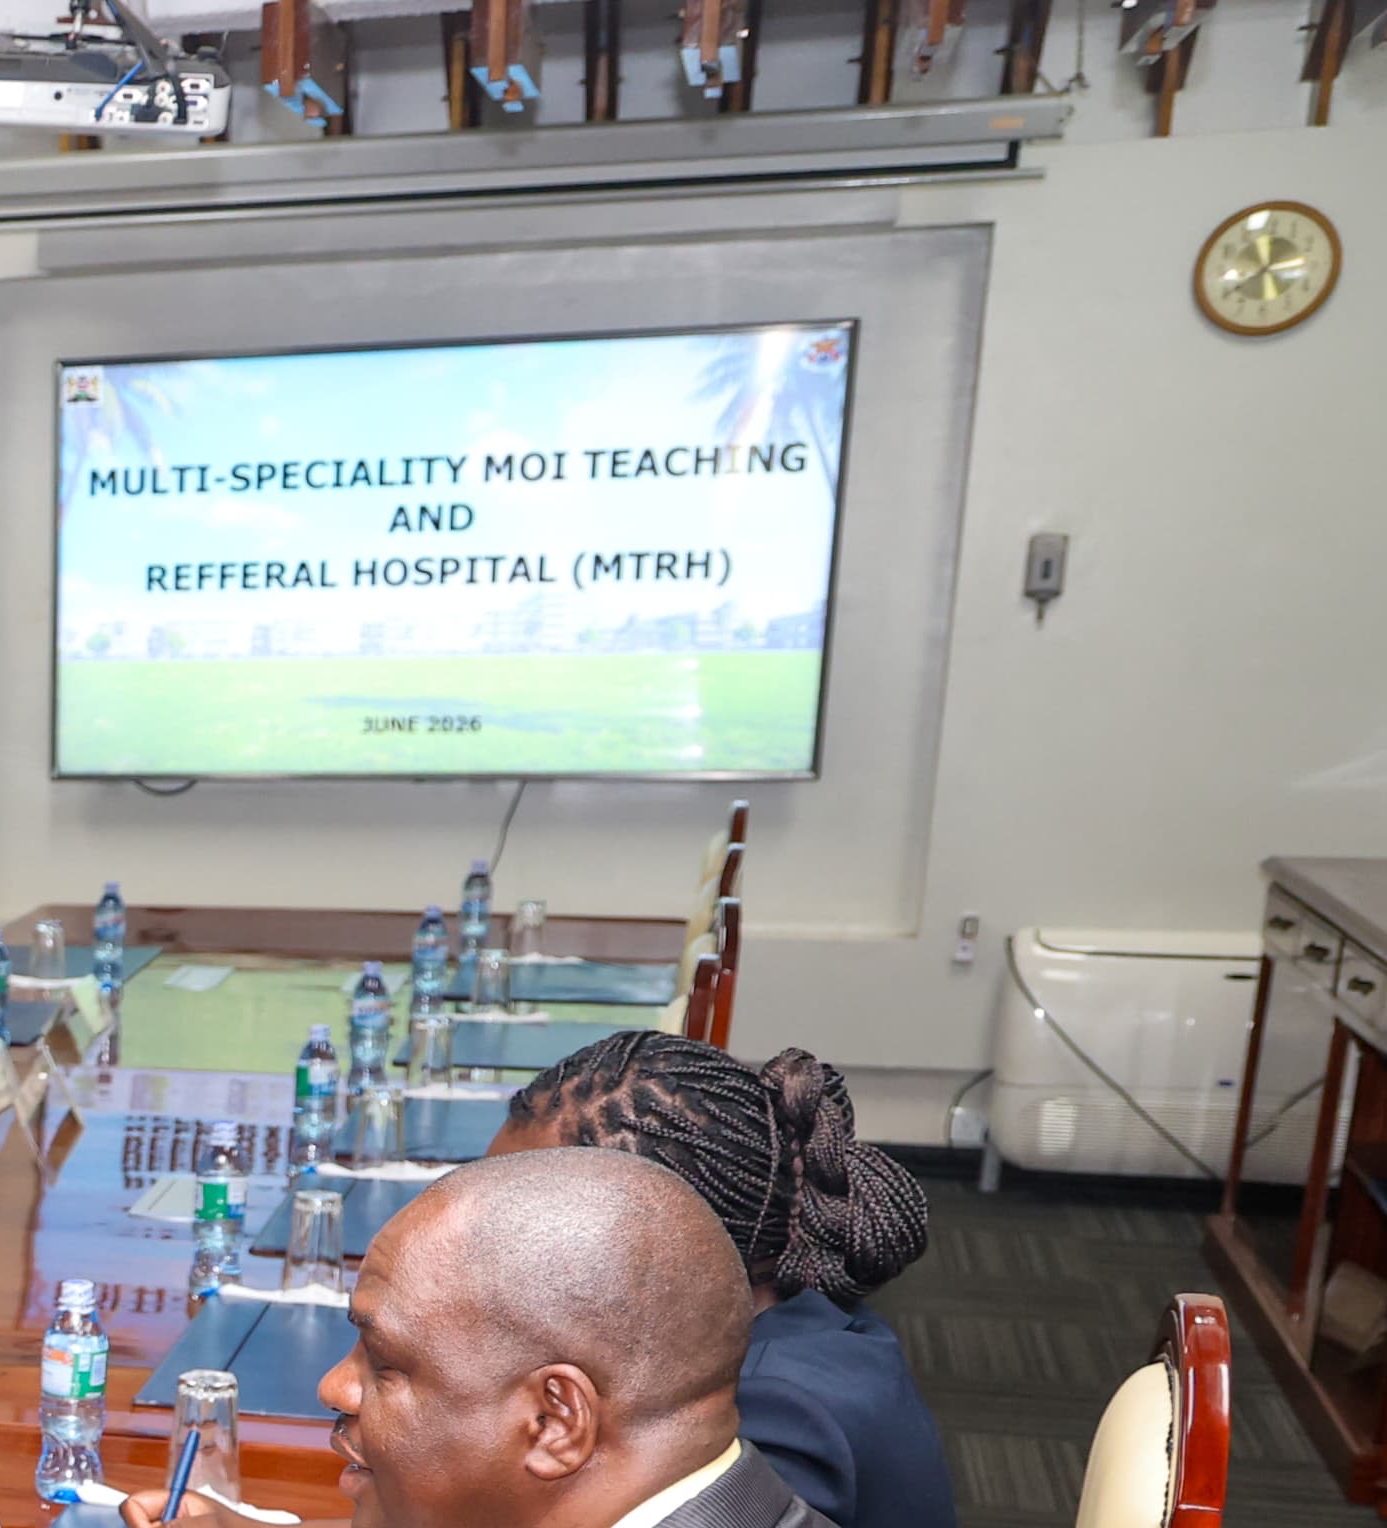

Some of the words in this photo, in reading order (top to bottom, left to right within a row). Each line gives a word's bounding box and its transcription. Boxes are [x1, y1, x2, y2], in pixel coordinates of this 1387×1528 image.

[89, 455, 468, 496] MULTI-SPECIALITY
[484, 451, 568, 483] MOI
[584, 442, 809, 479] TEACHING
[389, 503, 475, 533] AND
[145, 560, 337, 592] REFFERAL
[353, 555, 557, 587] HOSPITAL
[573, 547, 734, 589] (MTRH)
[362, 715, 420, 734] JUNE
